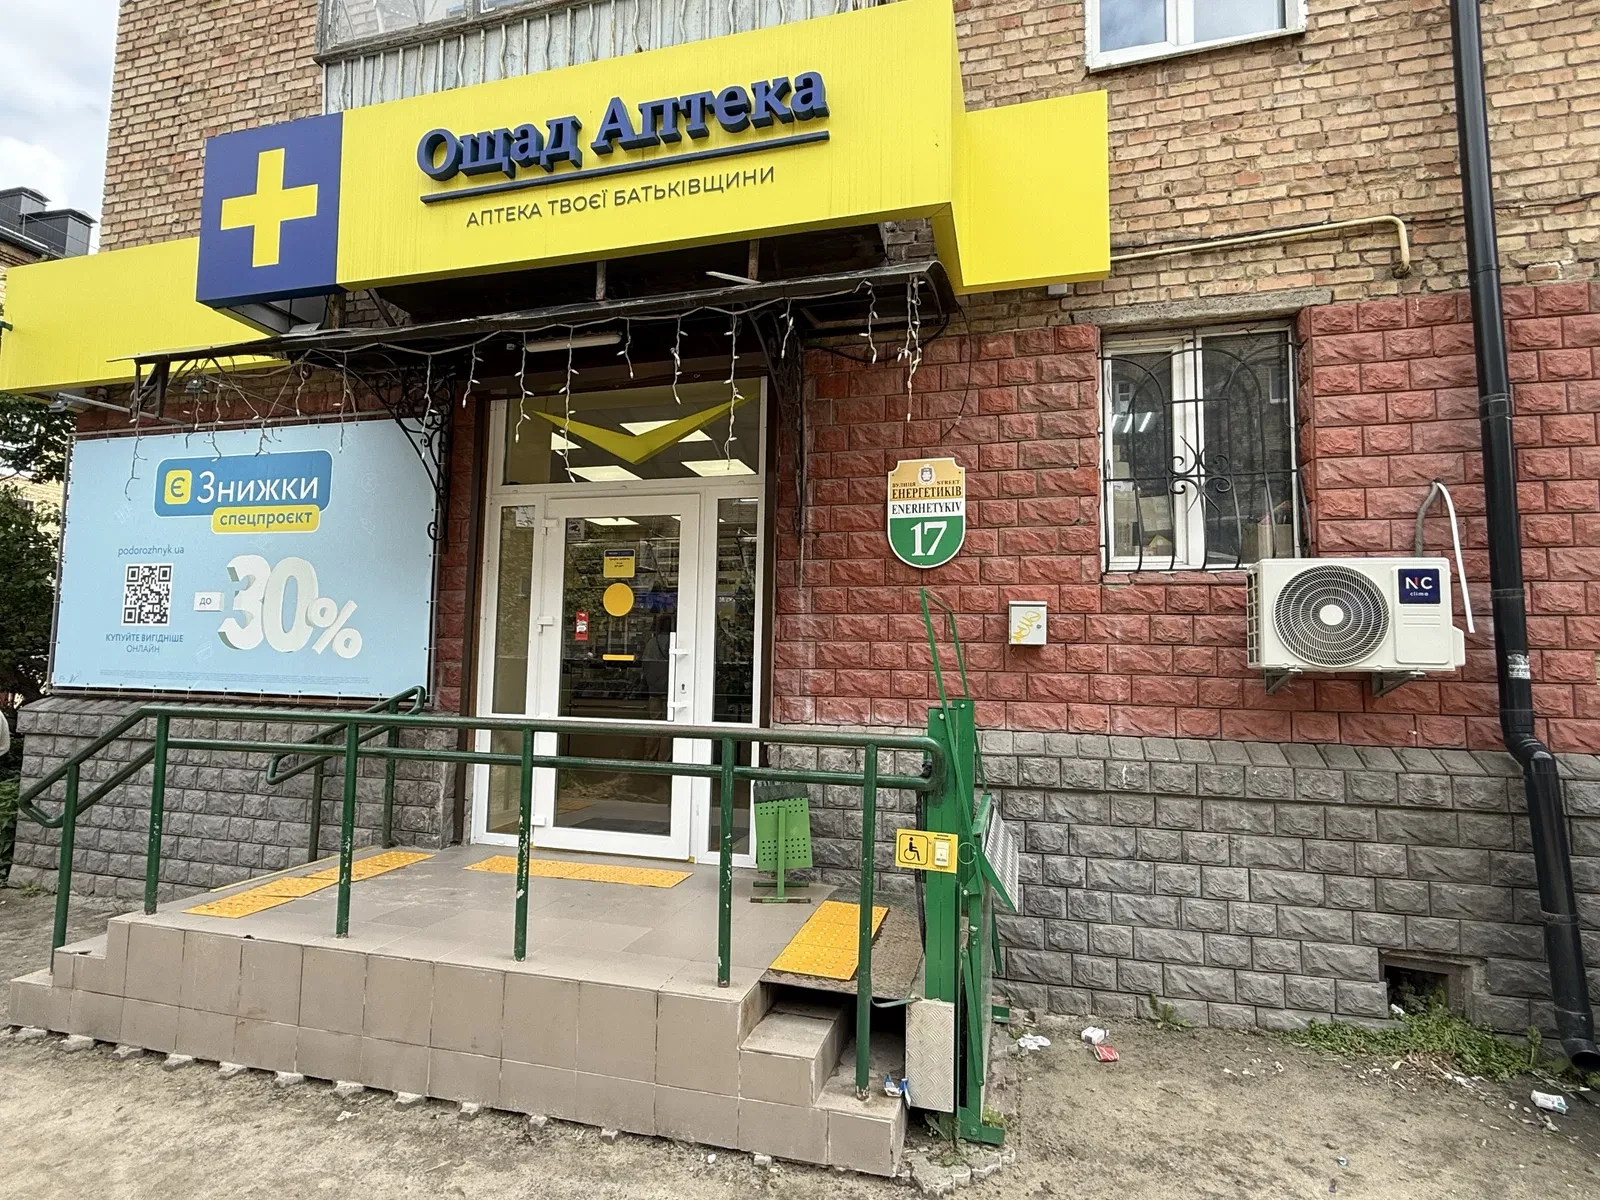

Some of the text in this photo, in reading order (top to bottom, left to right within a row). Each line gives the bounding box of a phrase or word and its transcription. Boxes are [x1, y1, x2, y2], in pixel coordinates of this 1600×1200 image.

[416, 70, 830, 182] Ощад Аптека
[466, 165, 775, 228] АПТЕКА ТВОЄЇ БАТЬКІВЩИНИ
[197, 471, 318, 503] Знижки
[892, 485, 962, 499] ЕНЕРГЕТИКІВ
[892, 501, 962, 515] ENERHETYKIV
[219, 511, 313, 528] спецпроєкт
[910, 521, 947, 556] 17
[117, 545, 184, 557] podorozhnyk.ua
[1405, 576, 1432, 589] NC
[199, 597, 212, 606] до
[105, 633, 184, 643] КУПУЙТЕ ВИГІДНІШЕ
[126, 643, 160, 653] ОНЛАЙН
